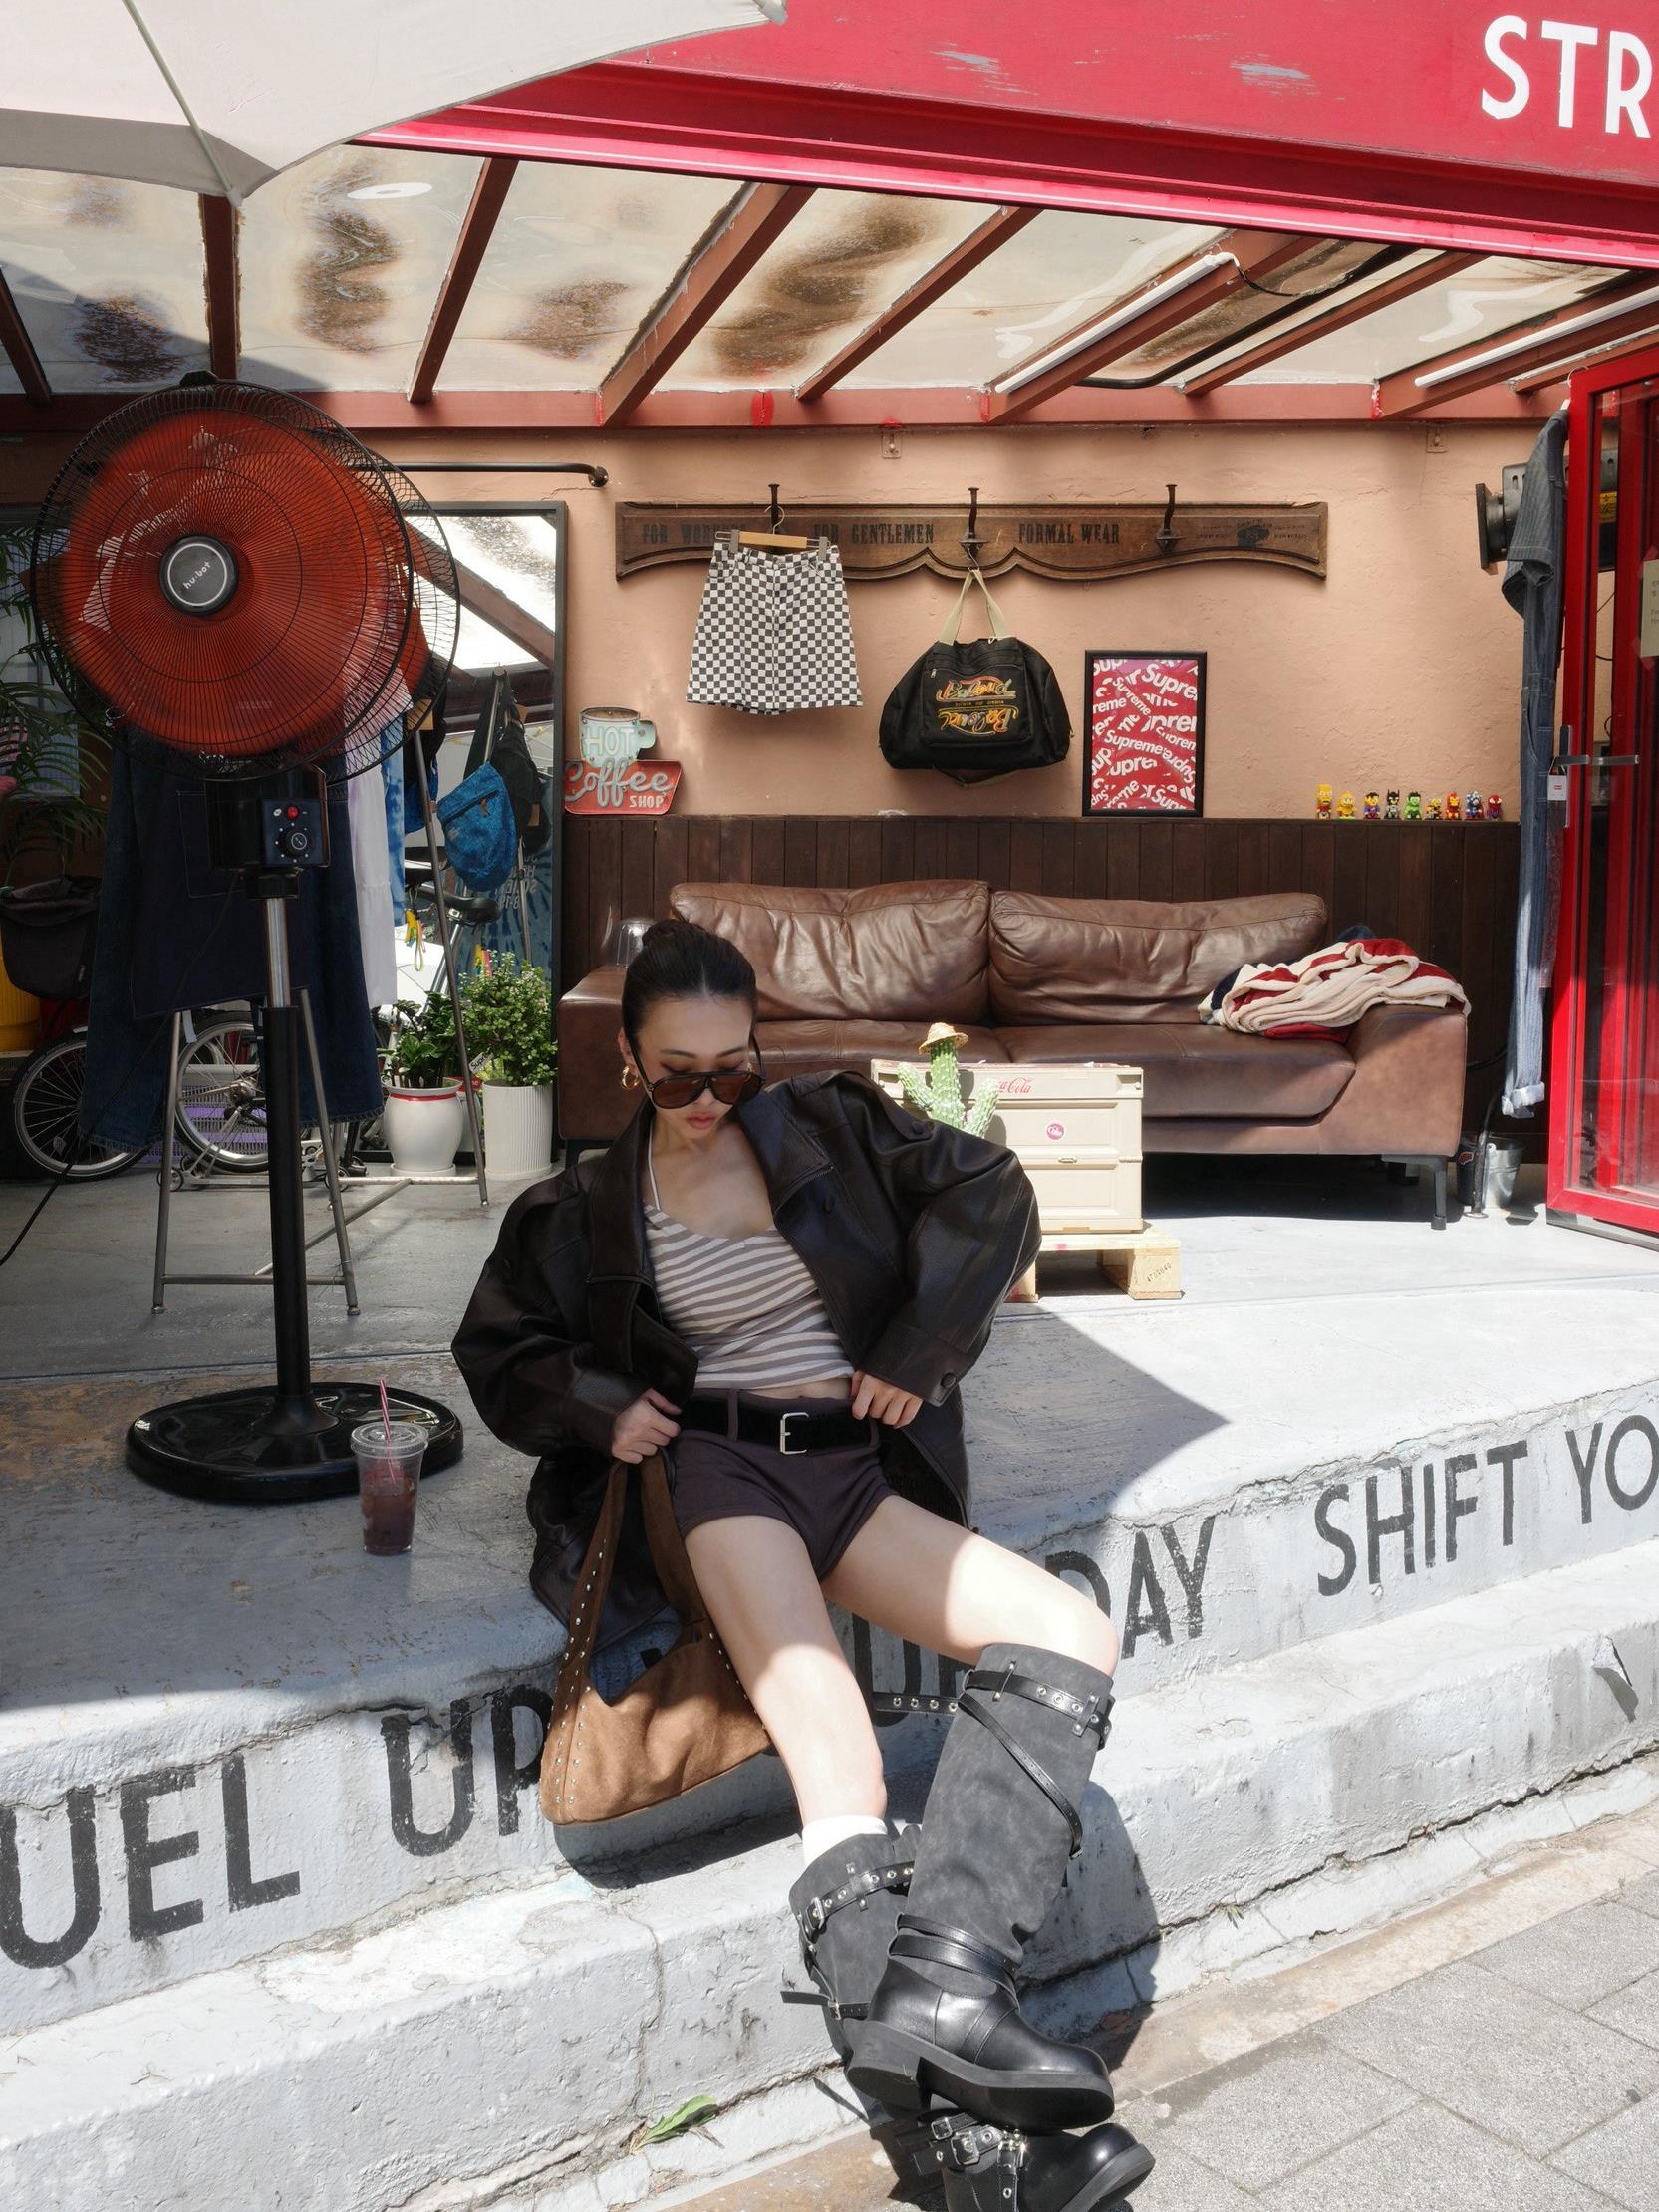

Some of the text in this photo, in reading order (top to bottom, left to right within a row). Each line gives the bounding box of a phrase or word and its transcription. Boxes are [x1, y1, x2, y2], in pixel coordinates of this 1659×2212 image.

[1481, 14, 1653, 138] STR
[851, 523, 934, 544] GENTLEMEN
[1018, 523, 1074, 544] FORMAL
[1080, 523, 1119, 544] WEAR
[585, 726, 636, 757] HOT
[1104, 730, 1163, 755] Supreme
[565, 758, 675, 807] Coffee
[629, 795, 665, 808] SHOP
[0, 1753, 300, 1970] UEL
[380, 1684, 554, 1857] UP
[1314, 1440, 1528, 1597] SHIFT
